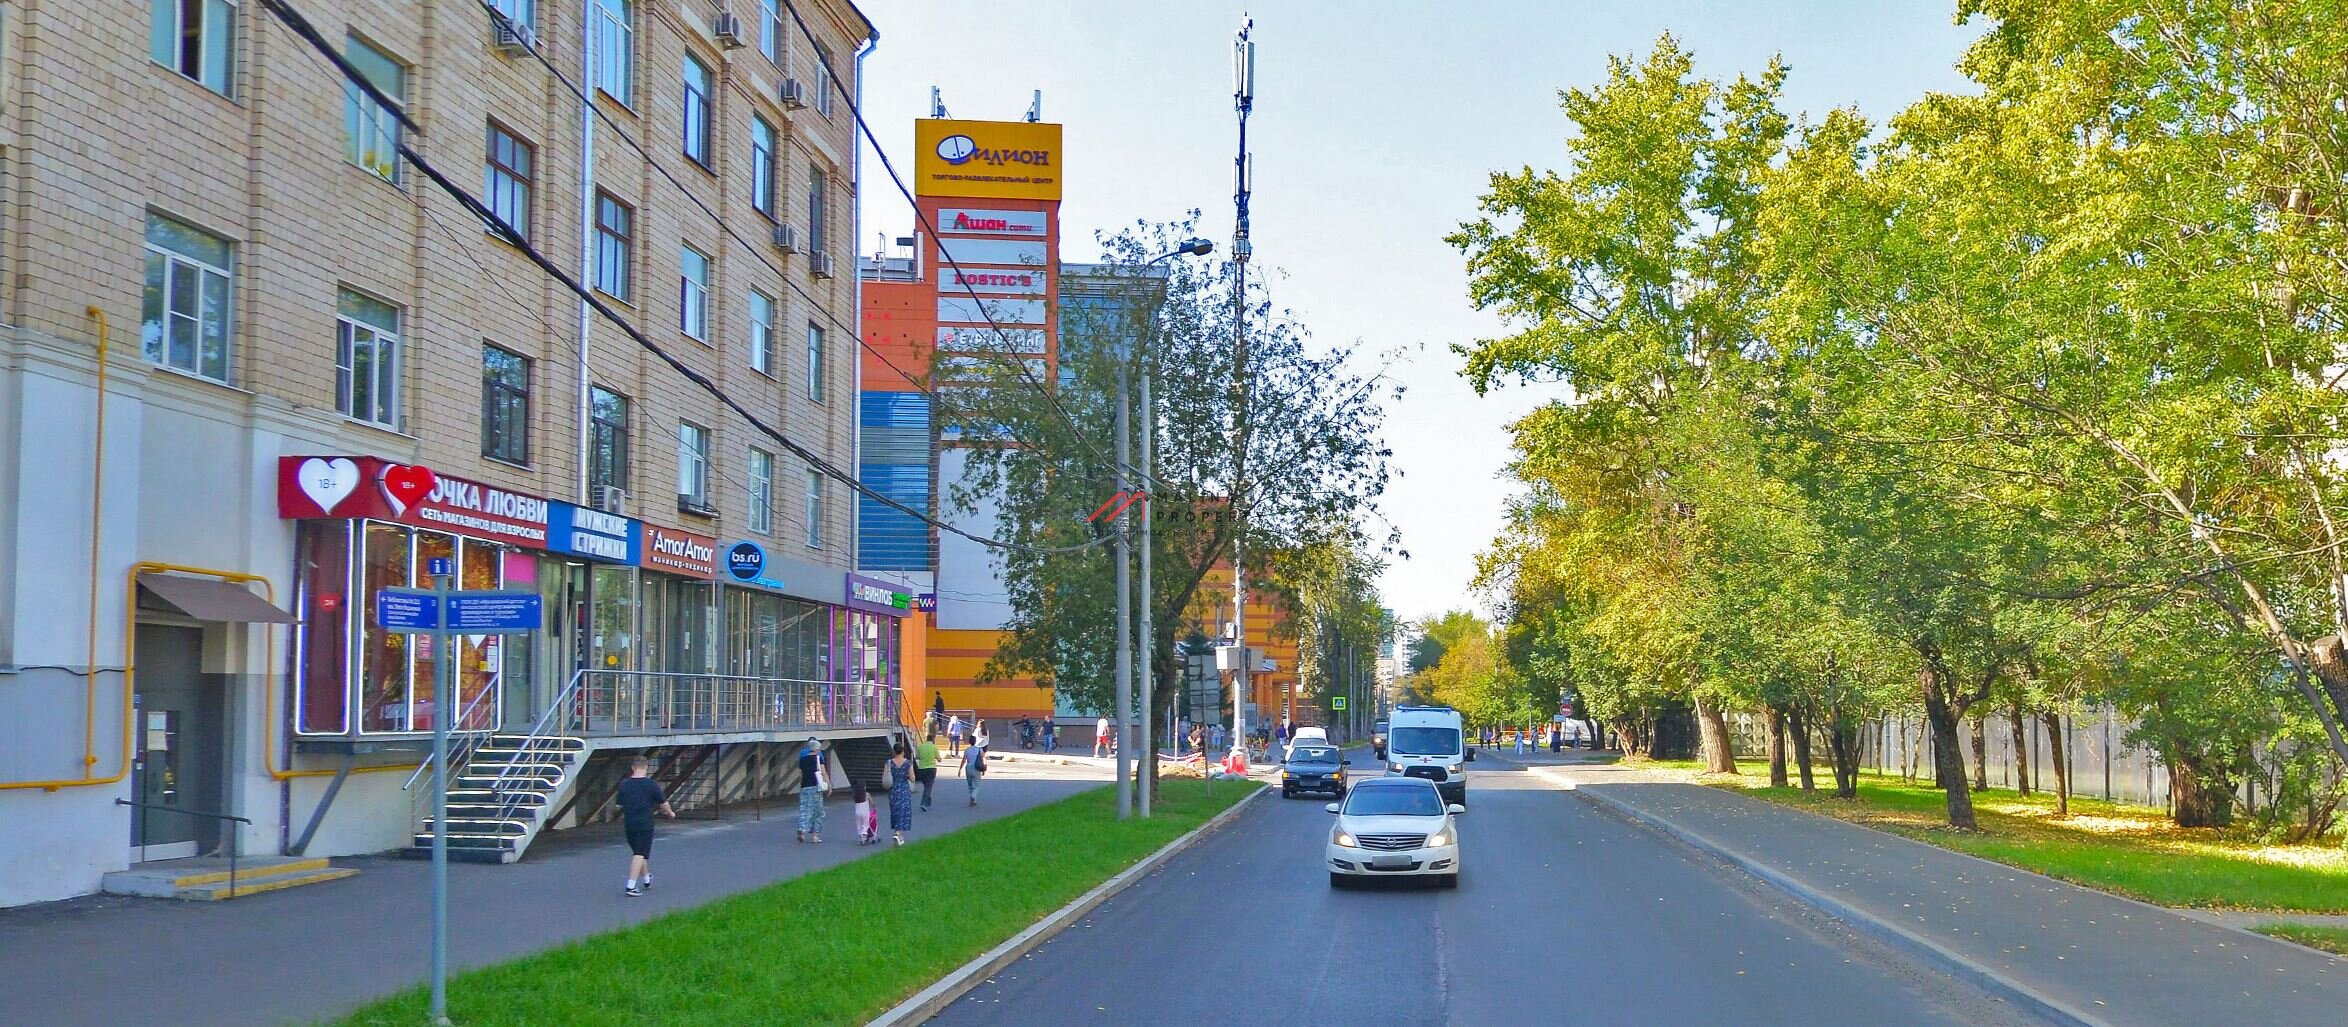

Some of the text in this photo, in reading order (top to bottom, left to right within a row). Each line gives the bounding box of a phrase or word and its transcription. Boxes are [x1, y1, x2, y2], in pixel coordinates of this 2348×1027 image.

[319, 479, 337, 489] 18+
[401, 481, 415, 489] 18+
[429, 475, 548, 524] ОЧКА ЛЮБВИ
[421, 507, 545, 541] СЕТЬ МАГАЗИНОВ ДЛЯ ВЗРОСЛЫХ
[573, 507, 628, 538] МУЖСКИЕ
[573, 531, 627, 560] СТРИЖКИ
